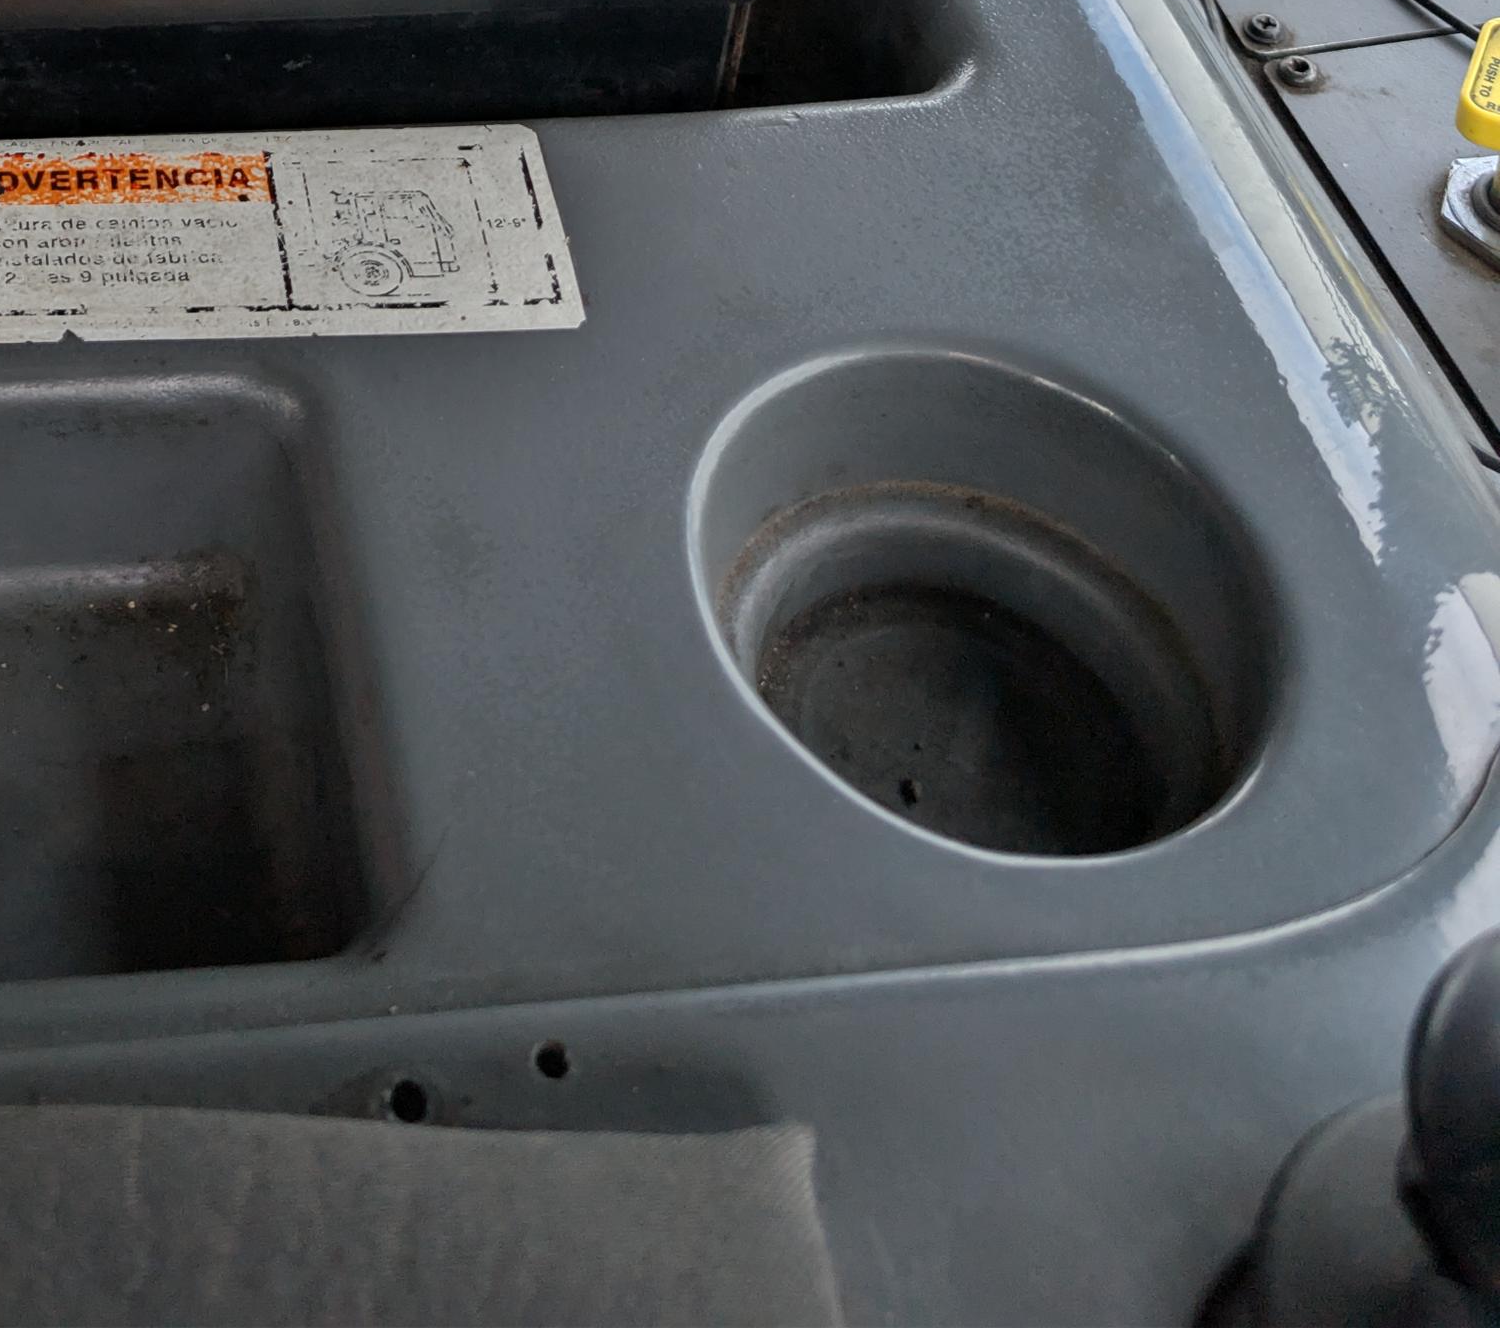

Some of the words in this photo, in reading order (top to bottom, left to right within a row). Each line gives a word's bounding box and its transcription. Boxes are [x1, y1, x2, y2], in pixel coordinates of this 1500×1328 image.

[1479, 84, 1493, 97] TO
[60, 218, 86, 230] de
[80, 270, 92, 283] 9
